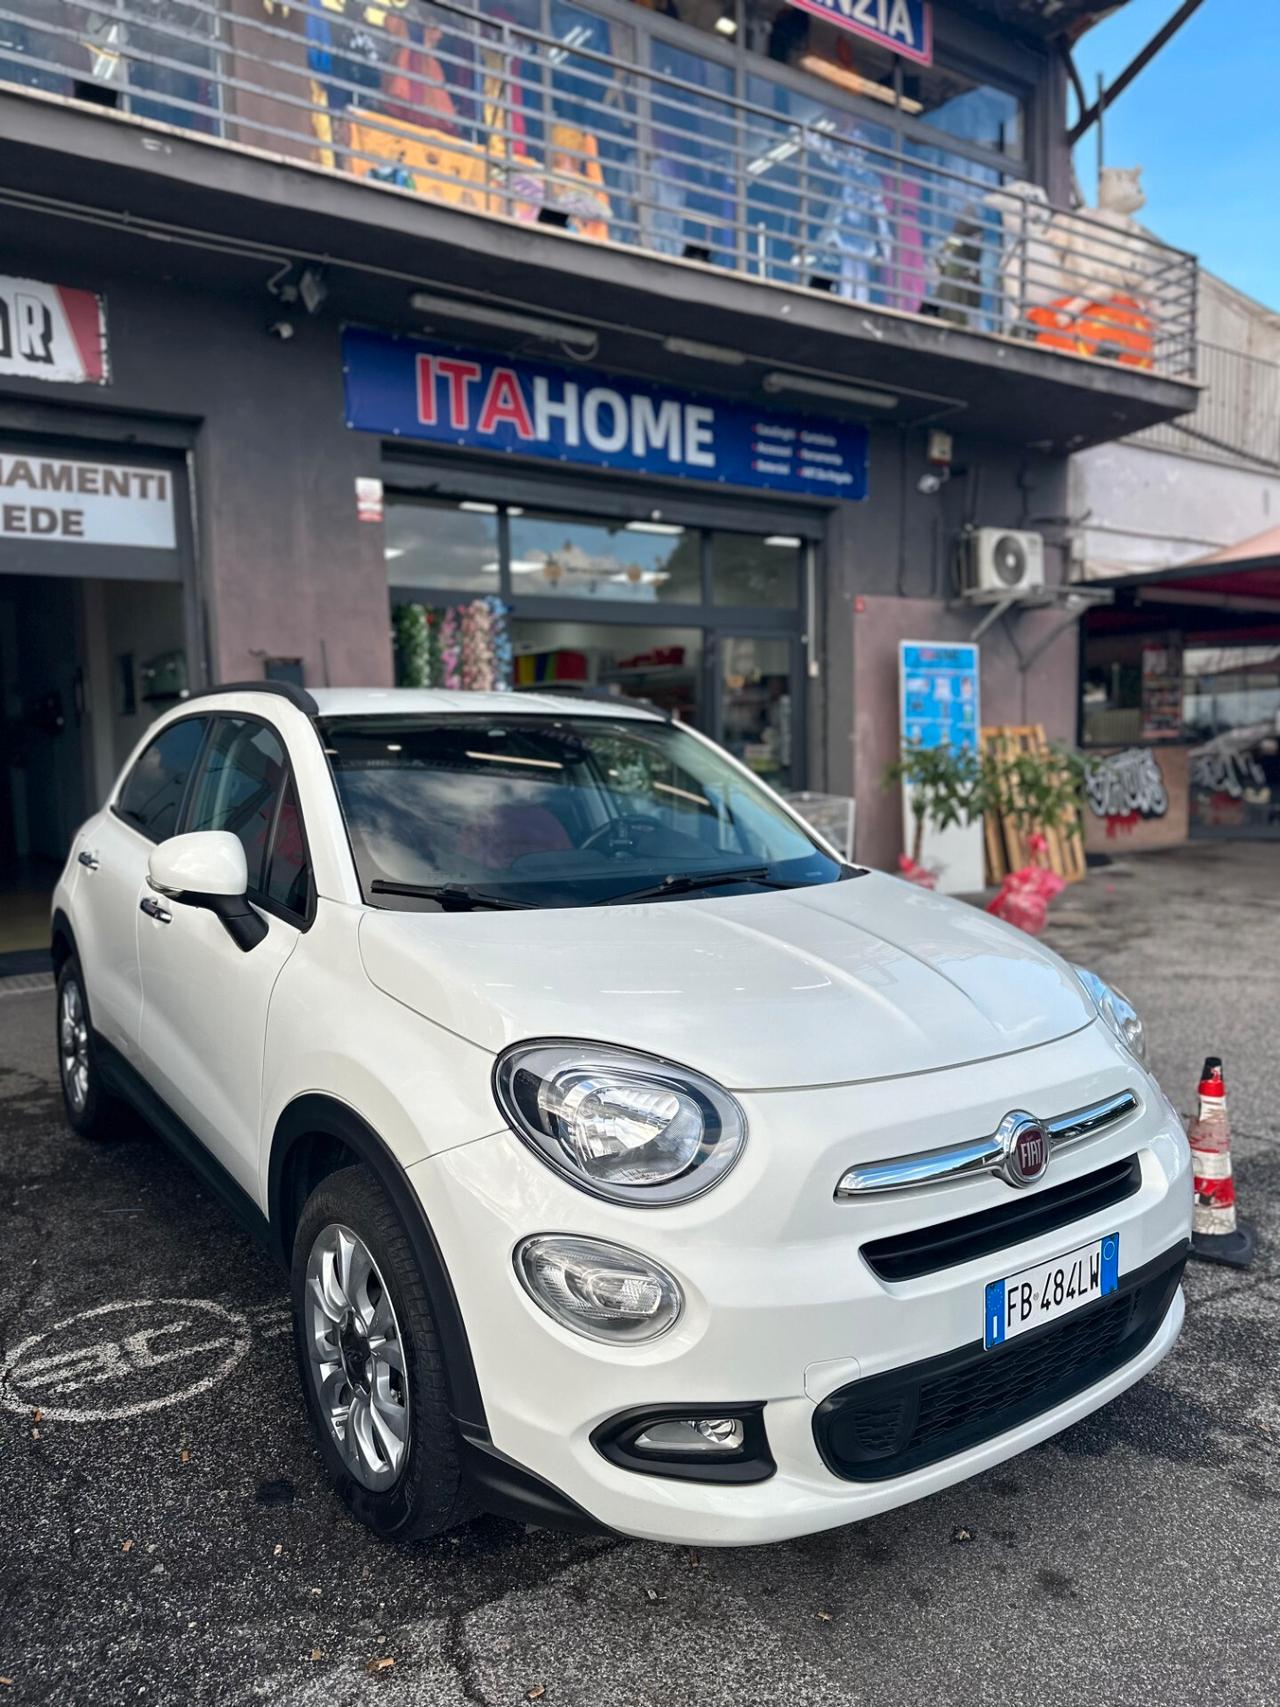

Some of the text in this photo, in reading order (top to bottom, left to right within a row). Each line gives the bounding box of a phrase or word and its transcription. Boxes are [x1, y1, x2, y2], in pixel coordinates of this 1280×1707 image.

[416, 352, 716, 468] ITAHOME
[3, 504, 83, 536] EDE
[1020, 1138, 1042, 1169] FIAT
[1007, 1282, 1033, 1327] FB
[1040, 1251, 1100, 1311] 484LW
